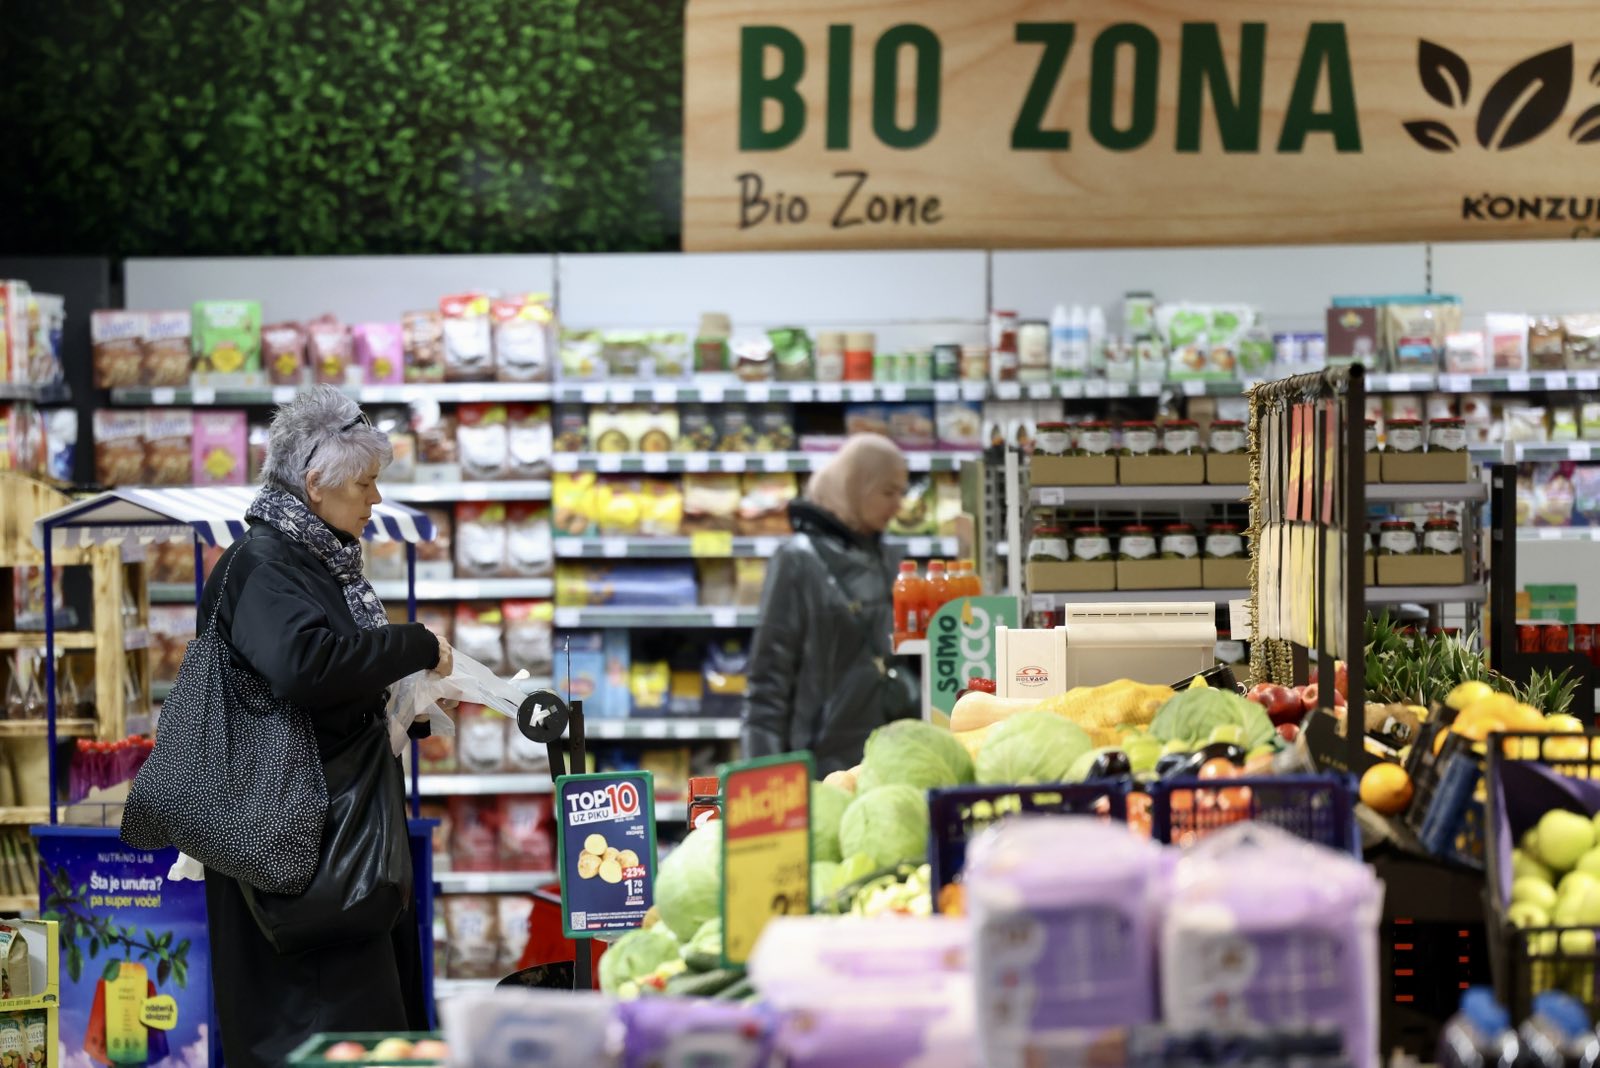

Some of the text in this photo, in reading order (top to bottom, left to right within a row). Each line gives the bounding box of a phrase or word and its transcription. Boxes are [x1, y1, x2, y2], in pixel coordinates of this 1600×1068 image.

[739, 21, 1363, 154] BIO ZONA
[735, 170, 945, 230] Bio Zone
[1462, 193, 1600, 220] KONZU
[937, 615, 959, 693] samo
[573, 813, 585, 822] UZ
[588, 810, 609, 820] PIKU
[98, 853, 154, 863] NUTRINO LAB
[90, 870, 163, 893] Šta je unutra?
[624, 866, 646, 878] -23%
[624, 880, 632, 895] 1
[90, 895, 103, 909] pa
[105, 895, 132, 909] super
